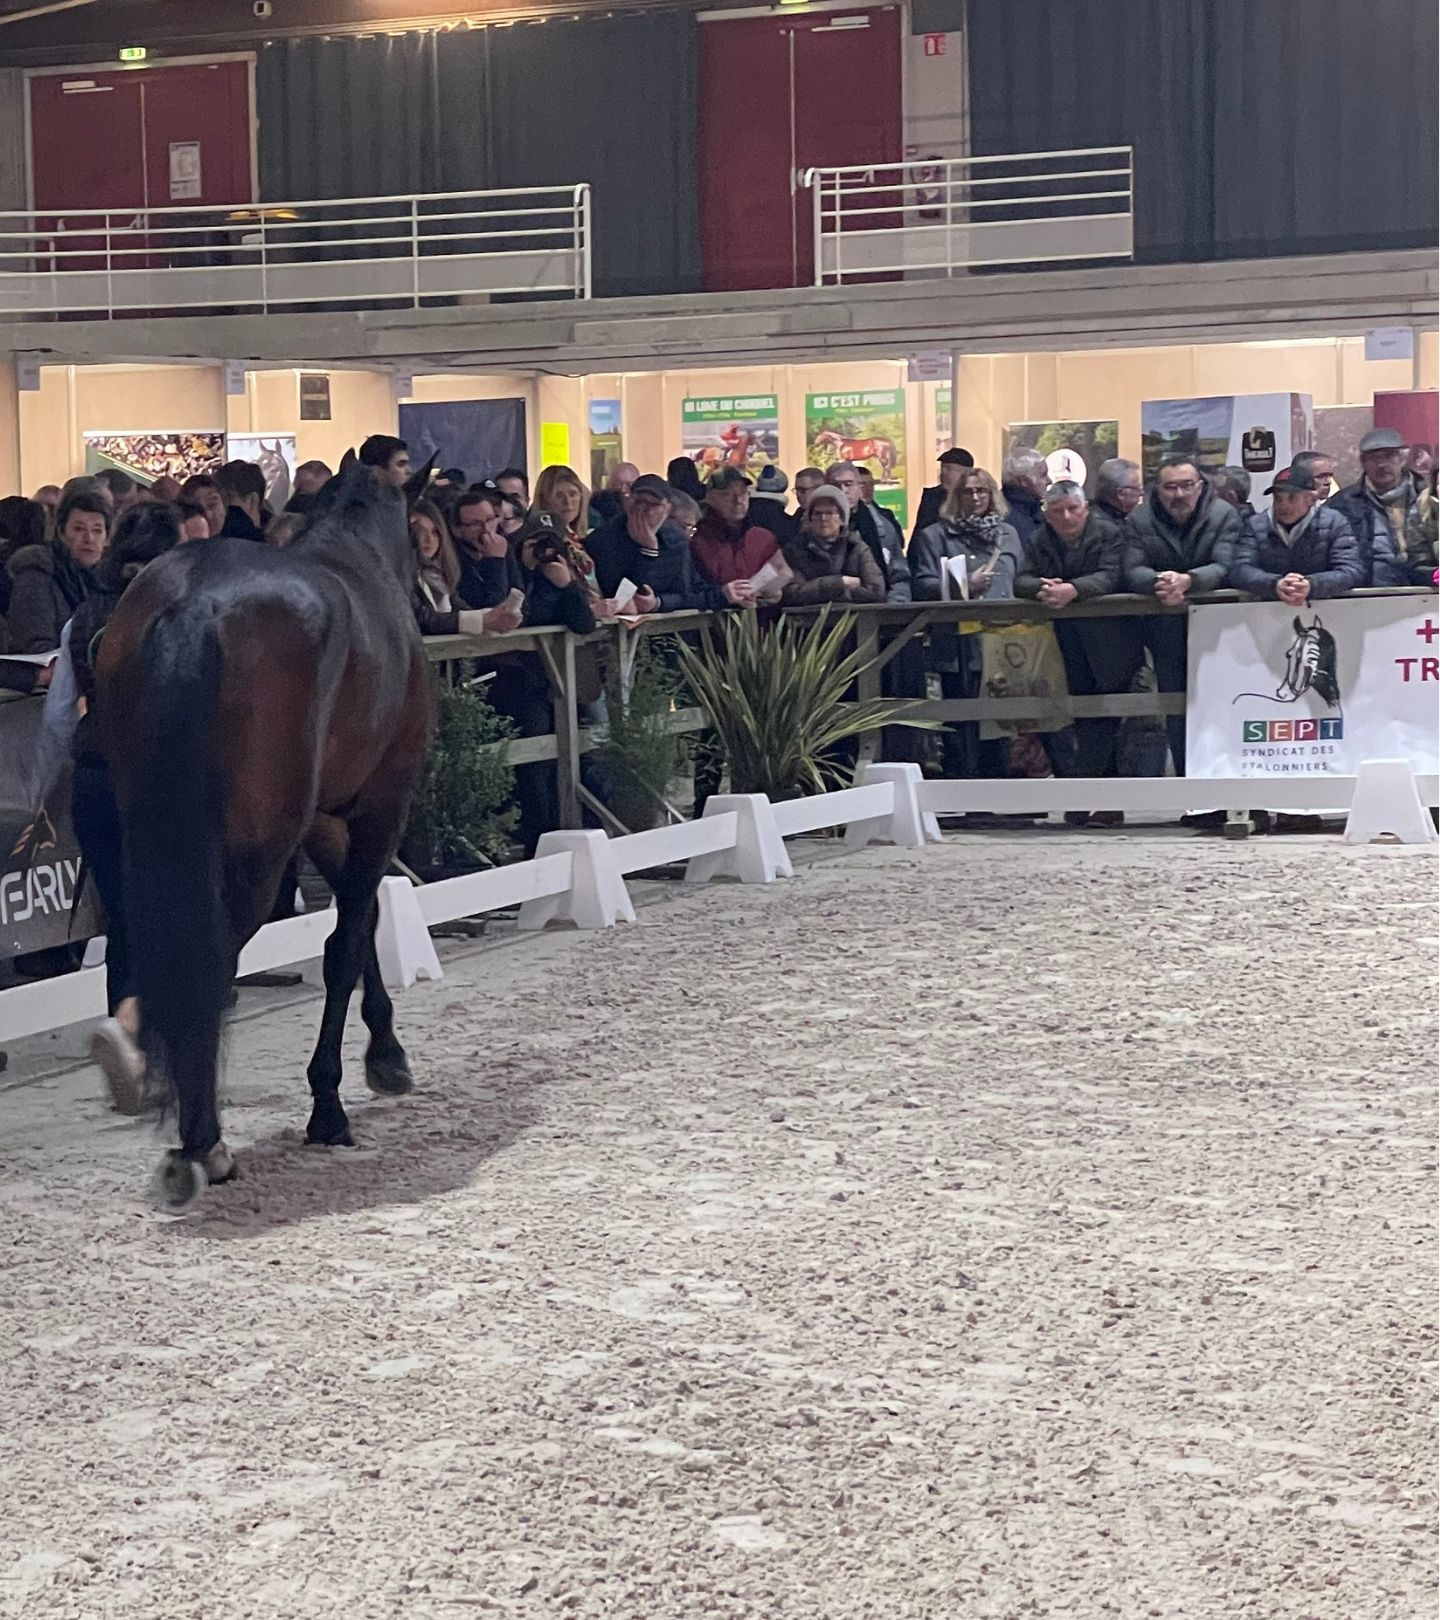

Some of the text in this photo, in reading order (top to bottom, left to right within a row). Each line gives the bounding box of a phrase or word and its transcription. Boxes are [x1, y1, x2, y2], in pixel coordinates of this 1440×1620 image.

[1247, 719, 1341, 741] SEPT
[1241, 745, 1335, 758] SYNDICAT DES
